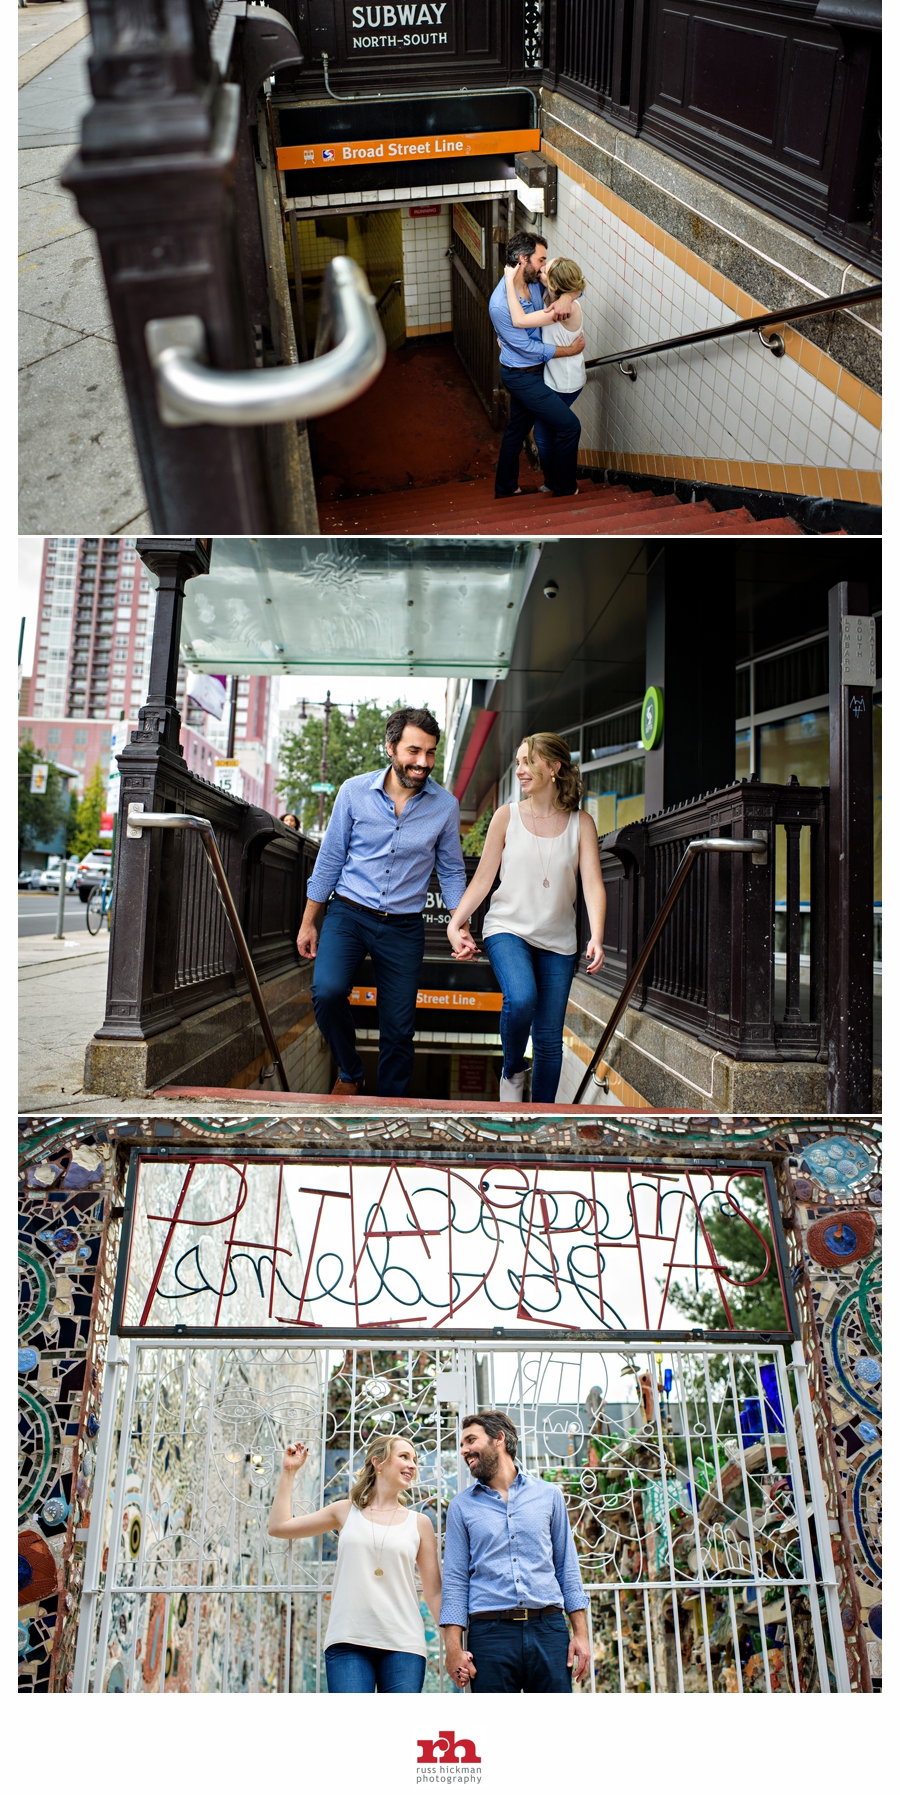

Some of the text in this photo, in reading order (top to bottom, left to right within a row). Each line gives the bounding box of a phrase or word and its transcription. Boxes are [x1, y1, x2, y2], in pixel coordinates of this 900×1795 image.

[352, 3, 447, 28] SUBWAY
[353, 32, 448, 49] NORTH-SOUTH
[342, 139, 464, 160] Broad Street Line
[219, 779, 232, 790] 15
[416, 993, 476, 1006] Street Line
